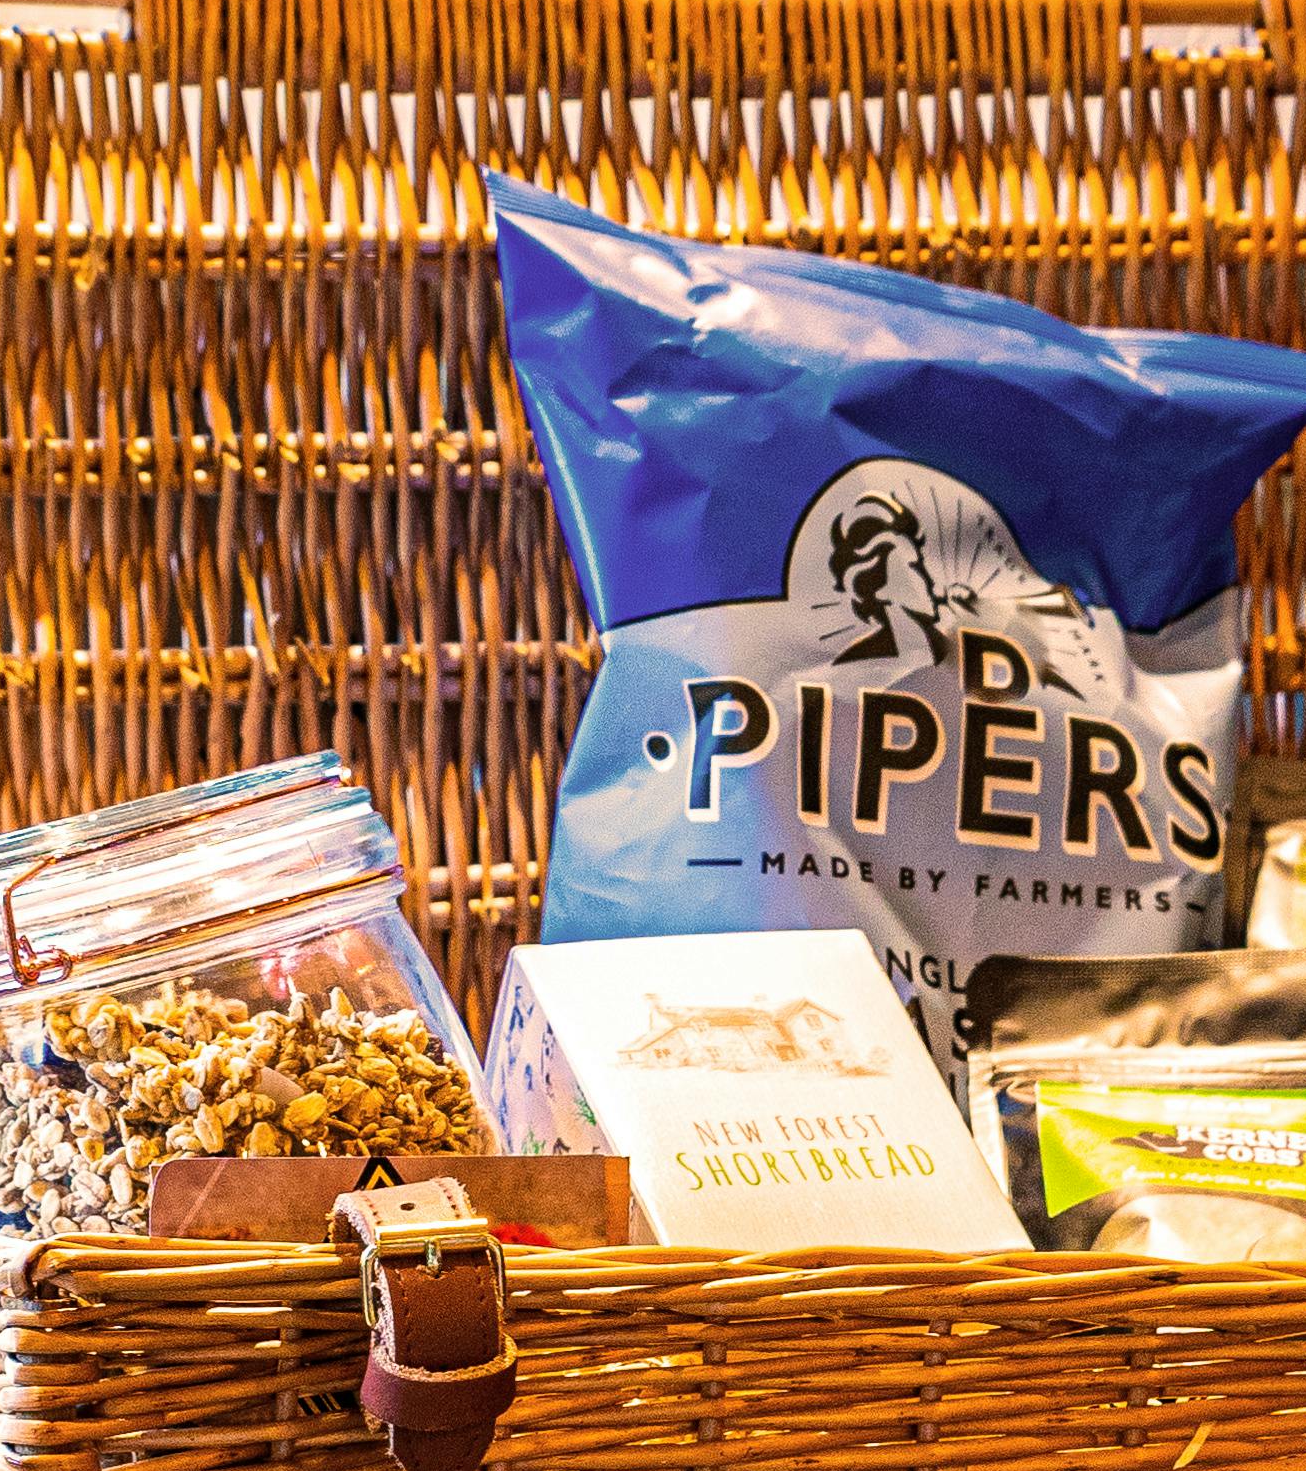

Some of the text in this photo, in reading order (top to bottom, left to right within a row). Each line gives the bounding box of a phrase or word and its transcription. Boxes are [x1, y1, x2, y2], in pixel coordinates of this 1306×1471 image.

[683, 676, 1226, 873] PIPERS
[760, 850, 1173, 913] MADE BY FARMERS
[693, 1113, 886, 1147] NEW FOREST
[675, 1143, 935, 1191] SHORTBREAD
[1203, 1142, 1303, 1167] COBS
